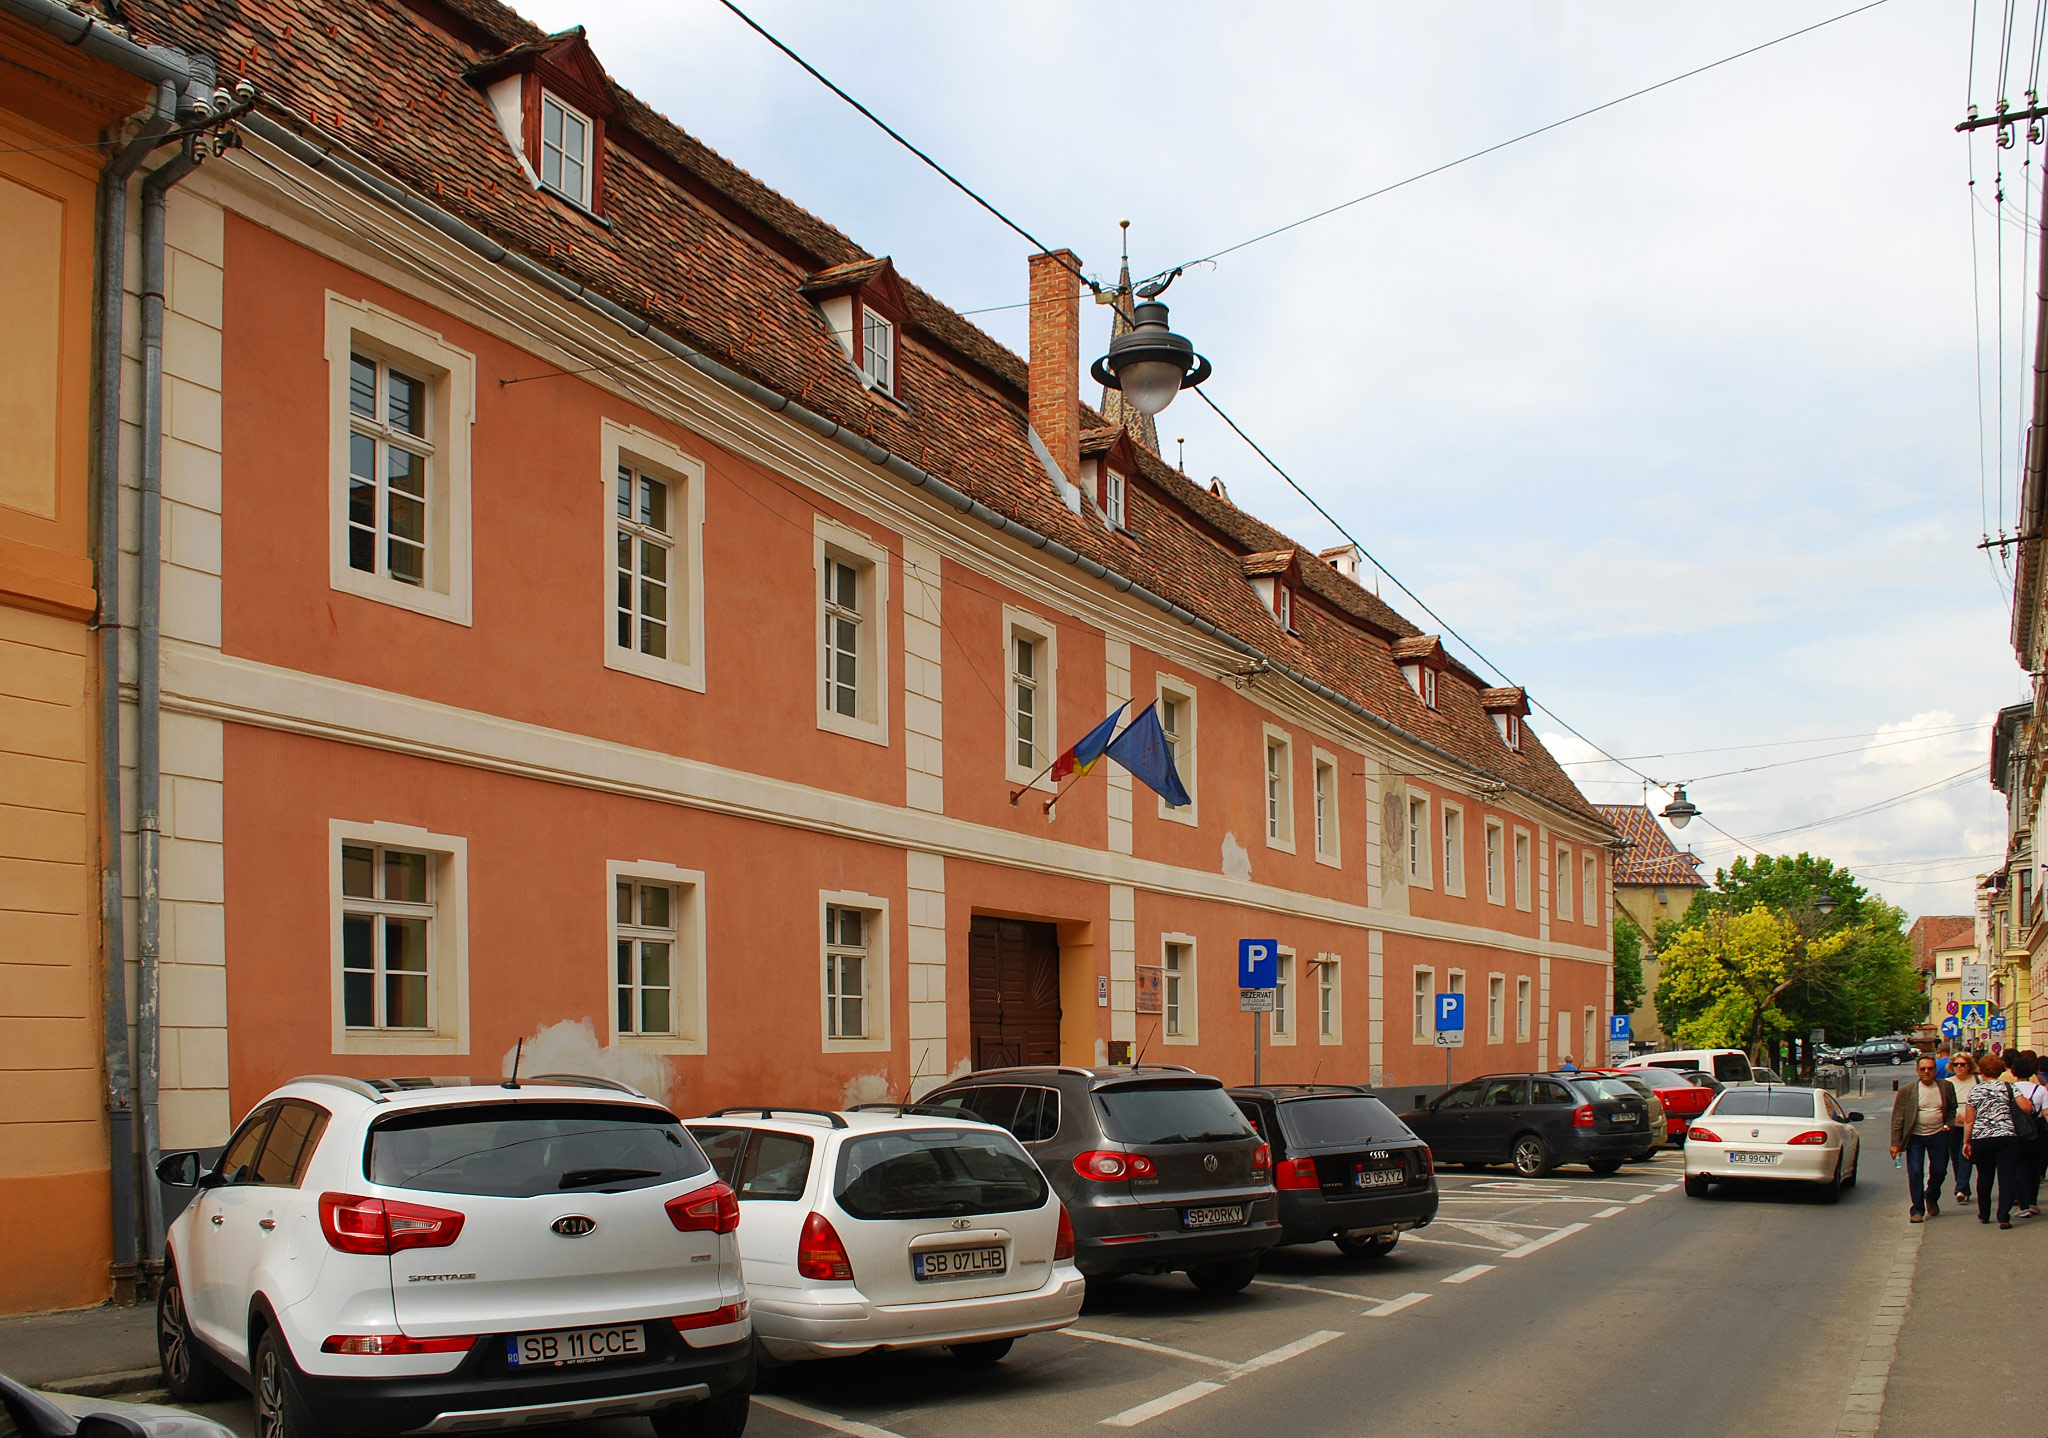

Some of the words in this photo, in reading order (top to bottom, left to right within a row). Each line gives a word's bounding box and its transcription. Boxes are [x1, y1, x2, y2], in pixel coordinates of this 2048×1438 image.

[1248, 945, 1268, 972] P
[1442, 998, 1458, 1019] P
[1615, 1017, 1626, 1033] P
[1748, 1154, 1776, 1163] 99CNT
[1134, 1179, 1159, 1187] TIGUAN
[1360, 1173, 1371, 1185] AB
[1189, 1208, 1205, 1224] SB
[1208, 1206, 1241, 1222] 20RKY
[558, 1219, 590, 1234] KIA
[925, 1254, 948, 1273] SB
[953, 1250, 1002, 1270] 07LHB
[408, 1272, 476, 1283] SPORTAGE
[524, 1337, 559, 1361] SB
